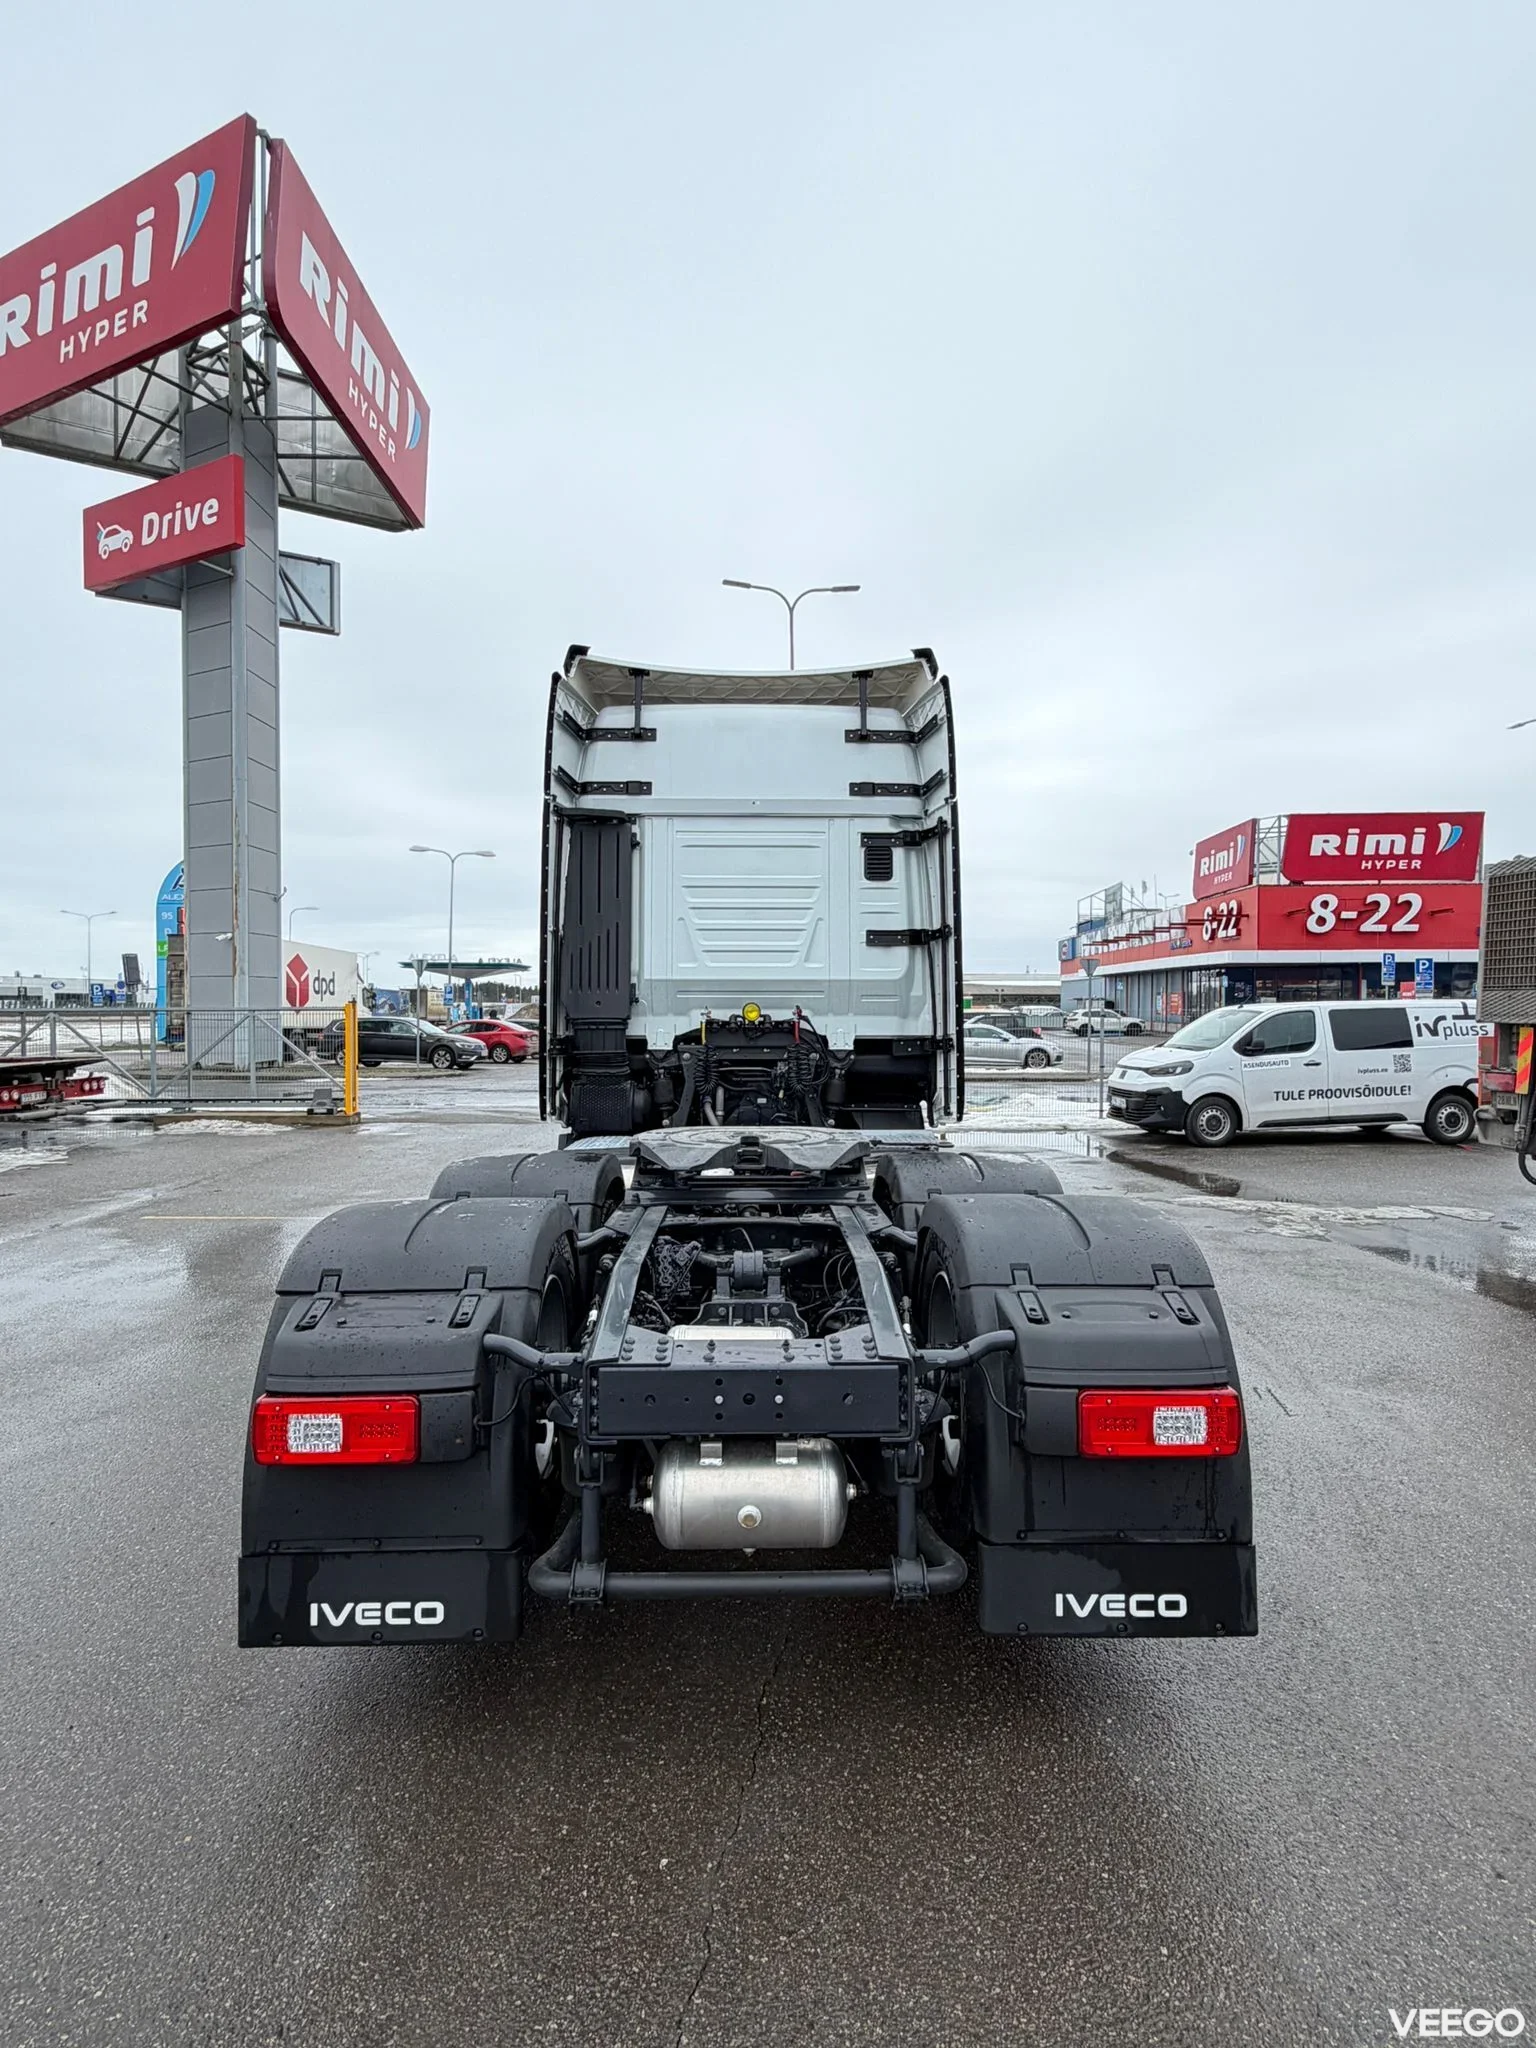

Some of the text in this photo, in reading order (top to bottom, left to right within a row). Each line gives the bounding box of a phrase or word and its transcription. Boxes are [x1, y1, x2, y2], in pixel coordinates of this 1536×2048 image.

[0, 205, 156, 358] Rimi
[59, 299, 149, 364] HYPER
[299, 230, 401, 433] Rimi
[347, 377, 396, 463] HYPER
[140, 496, 219, 546] Drive
[1309, 827, 1427, 856] Rimi
[1199, 841, 1235, 878] Rimi
[1361, 859, 1422, 870] HYPER
[1213, 871, 1233, 885] HYPER
[1306, 893, 1423, 934] 8-22
[1385, 954, 1393, 965] P
[1419, 960, 1430, 973] P
[313, 969, 336, 1002] dpd
[1243, 1059, 1290, 1069] ASENDUSAUTO
[1357, 1066, 1389, 1075] ivpluss.ee
[1273, 1084, 1412, 1102] TULE PROOVISÕIDULE!
[309, 1600, 445, 1628] IVECO
[1055, 1592, 1189, 1620] IVECO
